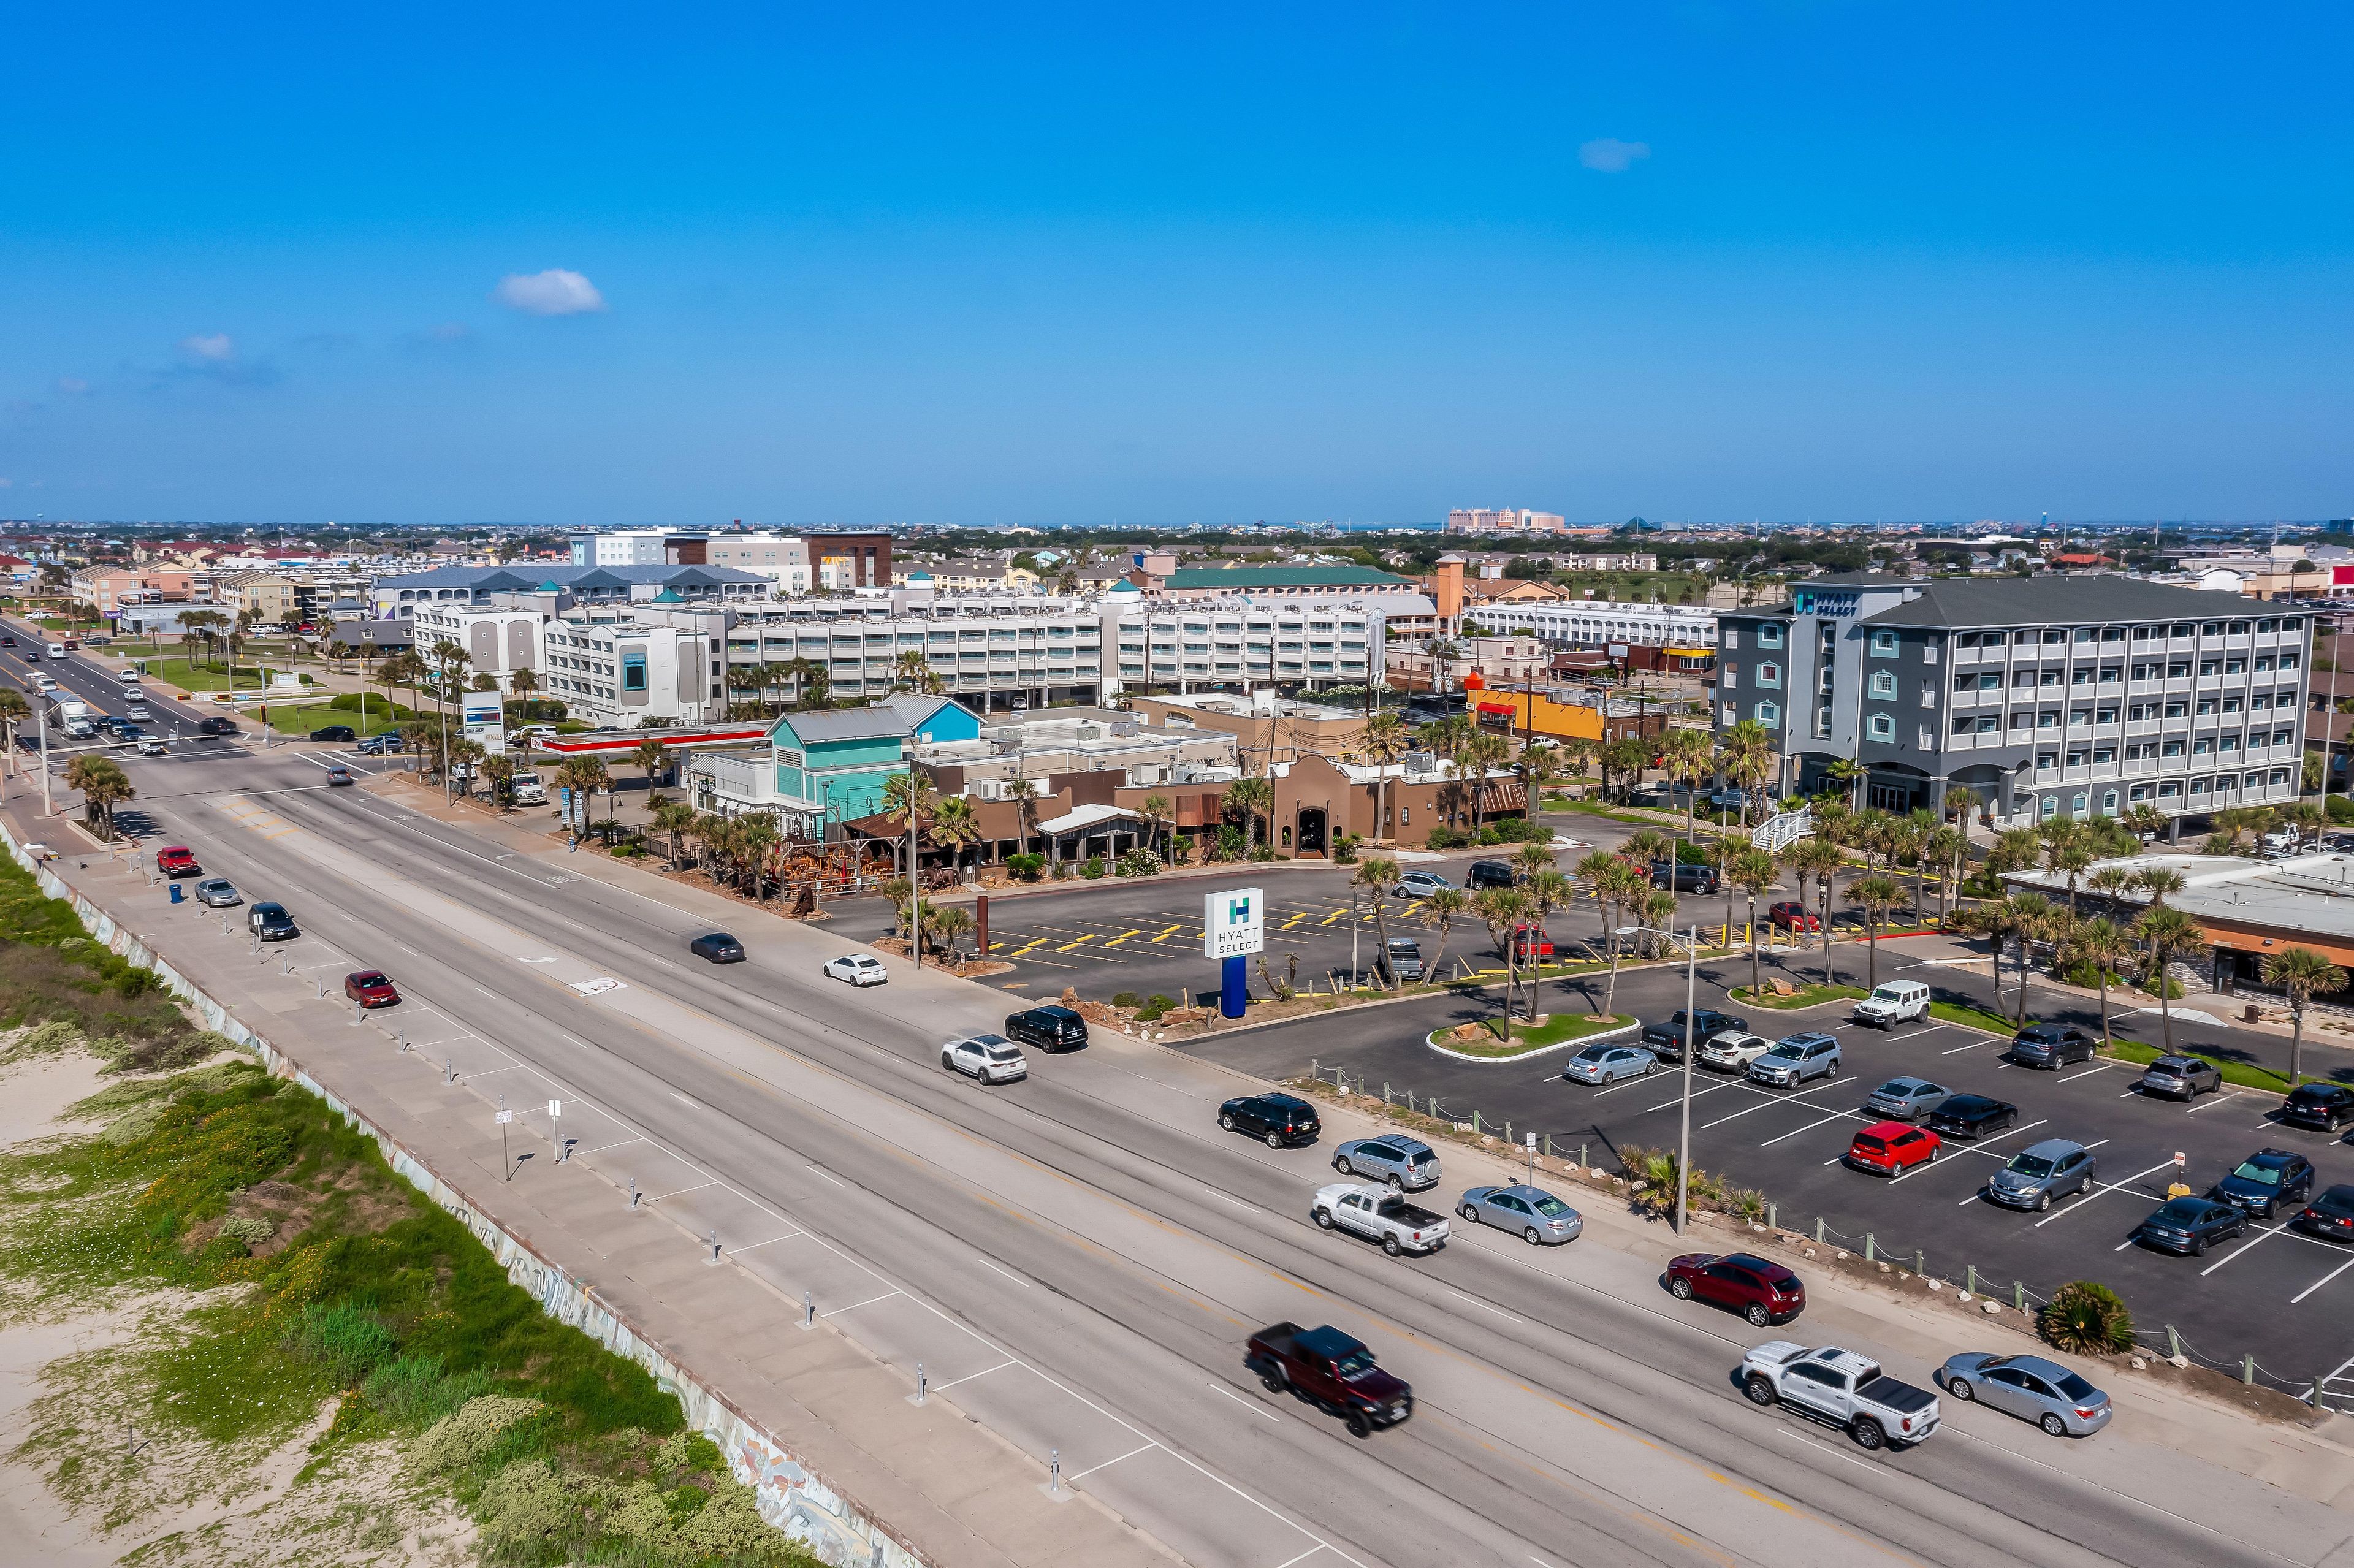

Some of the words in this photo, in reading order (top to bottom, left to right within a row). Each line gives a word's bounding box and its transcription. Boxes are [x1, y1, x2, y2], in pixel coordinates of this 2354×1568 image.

[1817, 606, 1857, 615] SELECT
[1219, 927, 1259, 943] HYATT
[1219, 940, 1258, 953] SELECT
